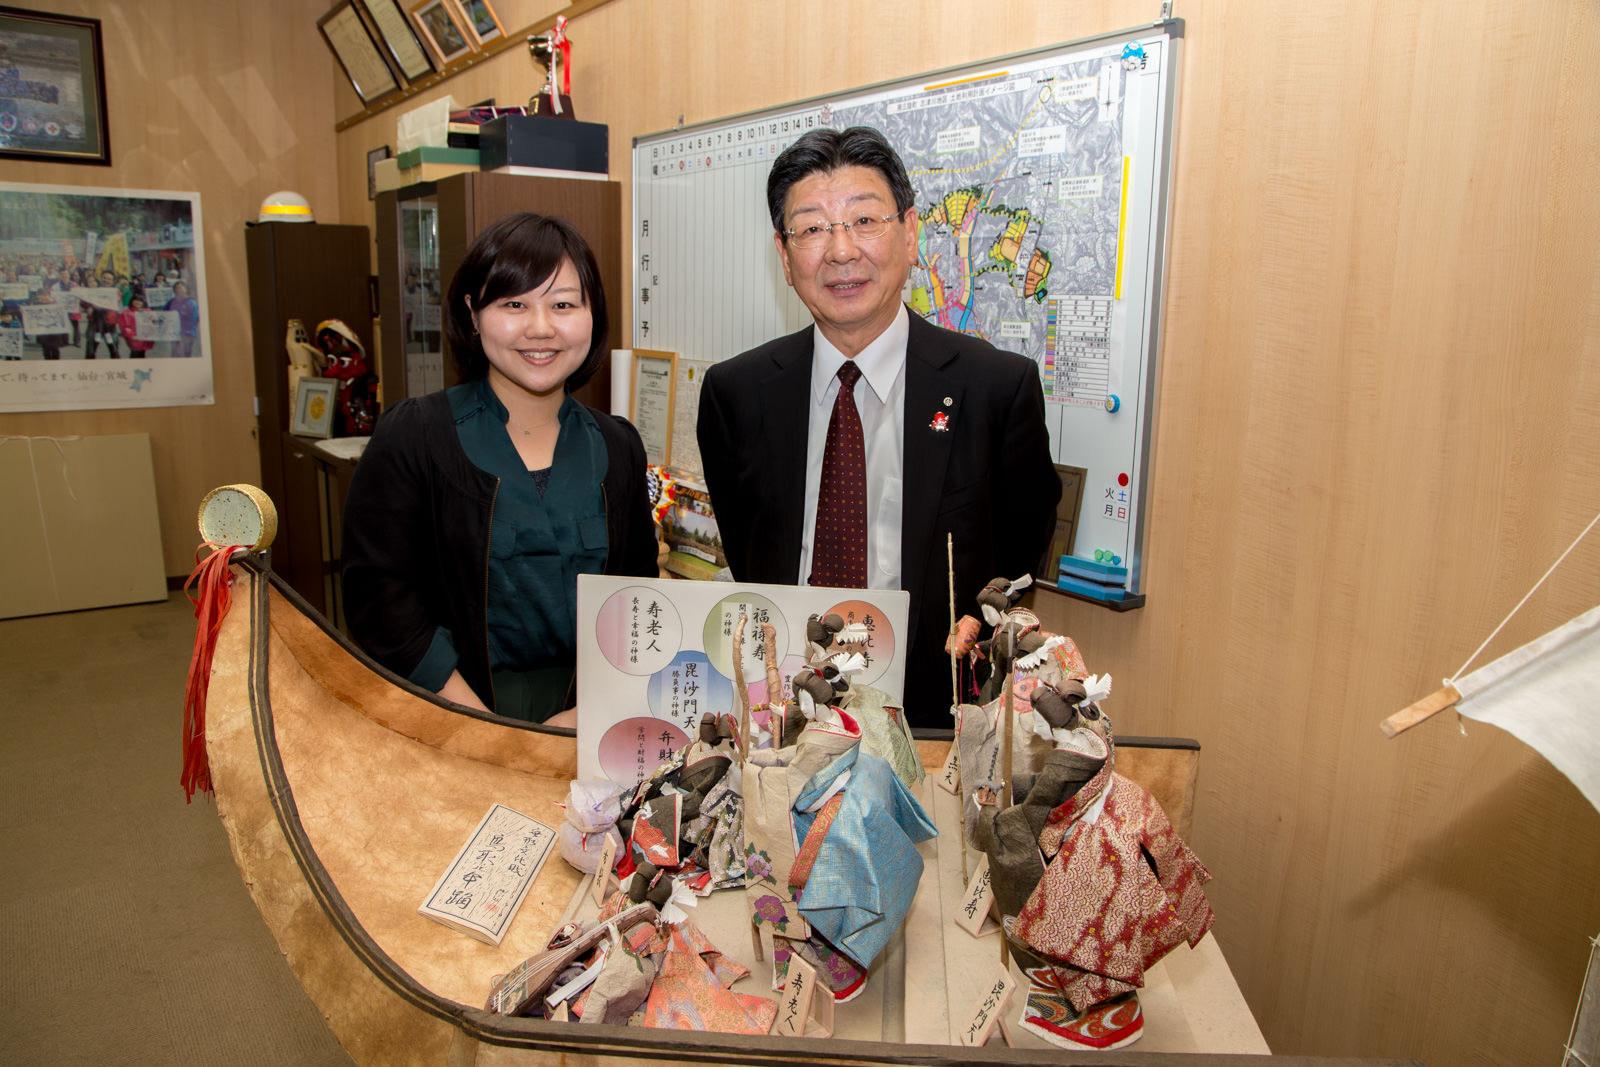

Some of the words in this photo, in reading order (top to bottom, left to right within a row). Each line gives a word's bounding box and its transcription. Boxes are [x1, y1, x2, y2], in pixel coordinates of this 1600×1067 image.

[670, 144, 675, 154] 2
[679, 143, 684, 152] 3
[688, 141, 693, 150] 4
[697, 139, 702, 148] 5
[707, 137, 712, 146] 6
[717, 135, 722, 144] 7
[727, 133, 732, 143] 8
[737, 131, 743, 140] 9
[747, 129, 755, 139] 10
[758, 126, 765, 137] 11
[769, 124, 777, 134] 12
[781, 122, 789, 132] 13
[792, 119, 801, 130] 14
[805, 117, 813, 127] 15
[1104, 504, 1113, 517] 月
[1117, 506, 1126, 519] 日
[1105, 487, 1114, 500] 火
[1117, 490, 1127, 503] 土
[630, 596, 640, 664] 長寿と幸福の神様
[646, 600, 663, 653] 寿老人
[671, 669, 680, 718] 勝負事の神様
[683, 662, 699, 729] 毘沙門天
[658, 730, 675, 761] 弁財
[784, 972, 803, 1033] 寿老人
[967, 979, 1005, 1043] 毘沙門天
